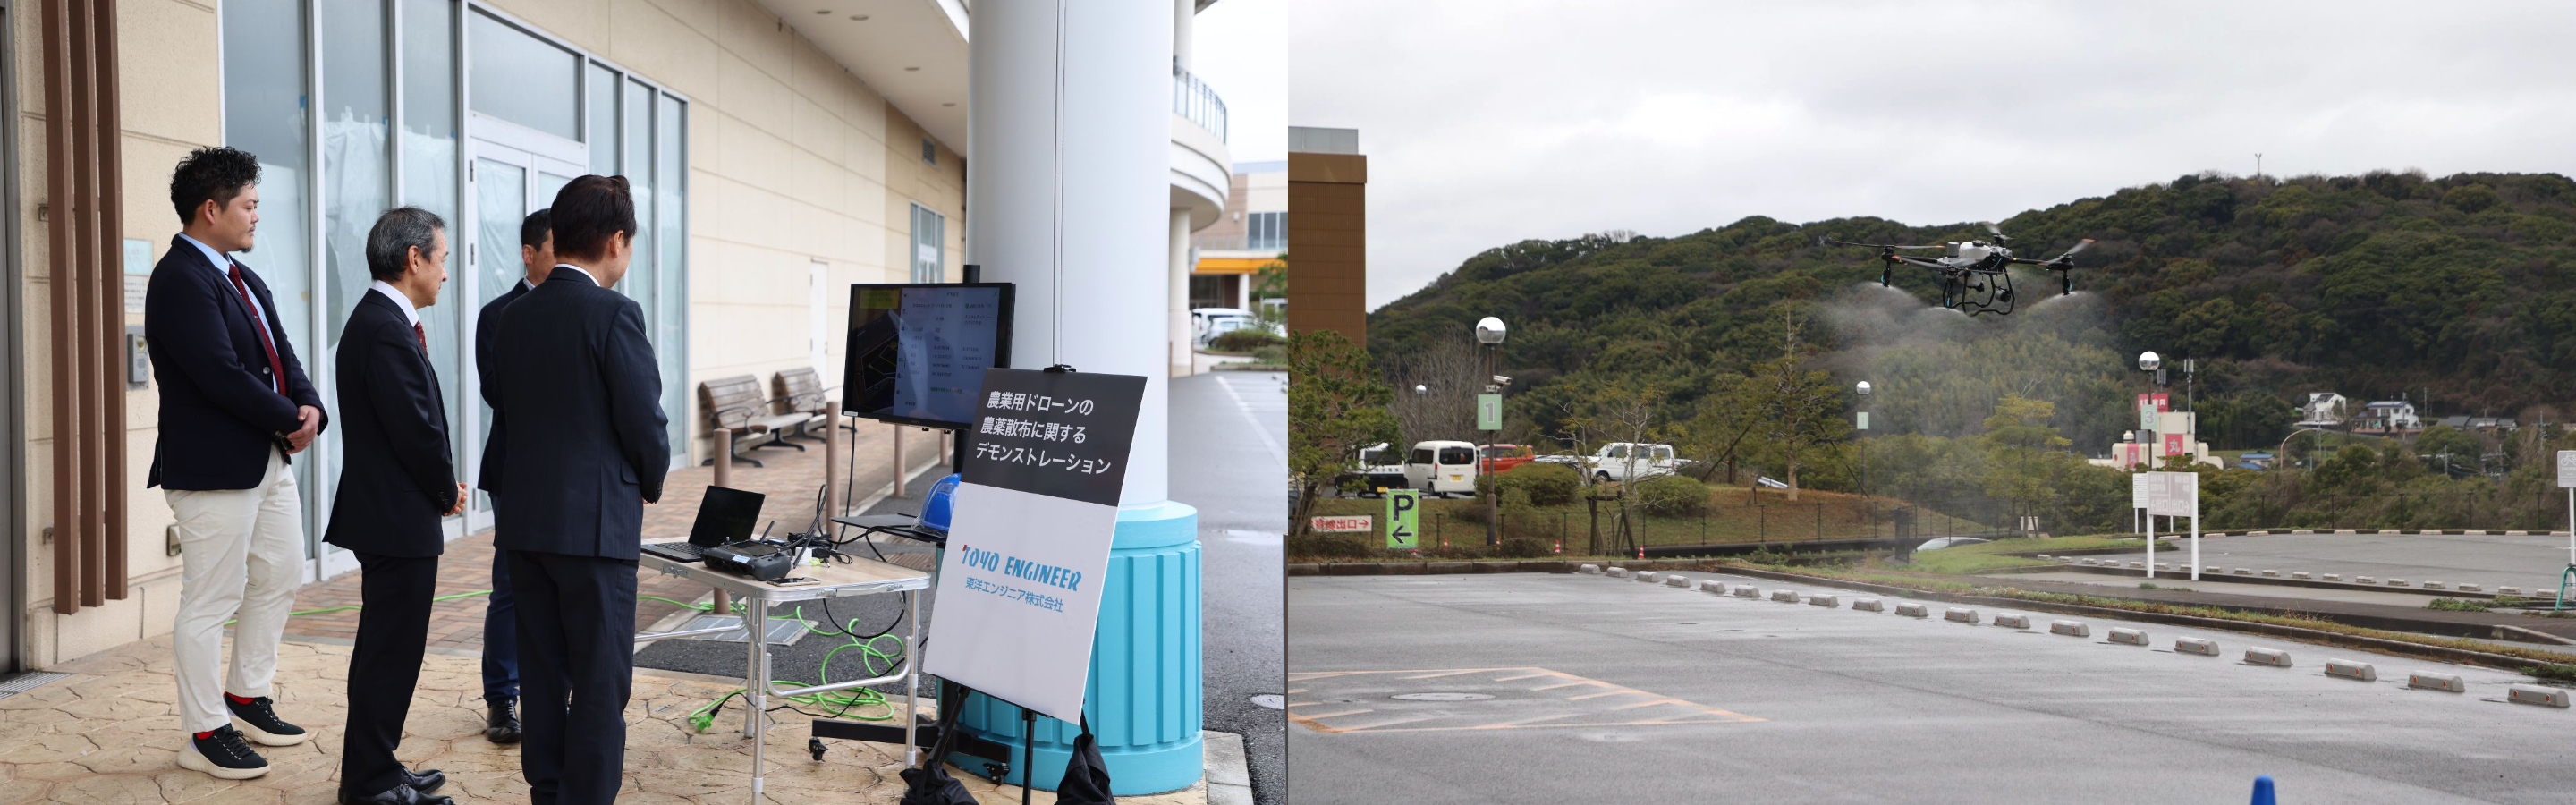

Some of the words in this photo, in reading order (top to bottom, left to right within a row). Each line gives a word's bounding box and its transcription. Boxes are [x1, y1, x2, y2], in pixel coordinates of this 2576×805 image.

[987, 391, 1094, 416] 農業用ドローンの
[1484, 402, 1495, 423] 1
[980, 417, 1087, 444] 農薬散布に関する
[2144, 410, 2155, 425] 3
[976, 441, 1112, 475] デモンストレーション
[1393, 494, 1414, 521] P
[2155, 498, 2169, 513] 出口
[2172, 498, 2184, 513] 出口
[962, 544, 1000, 572] TOYO
[1004, 555, 1082, 592] ENGINEER
[965, 577, 1064, 613] 東洋エンジニア株式会社
